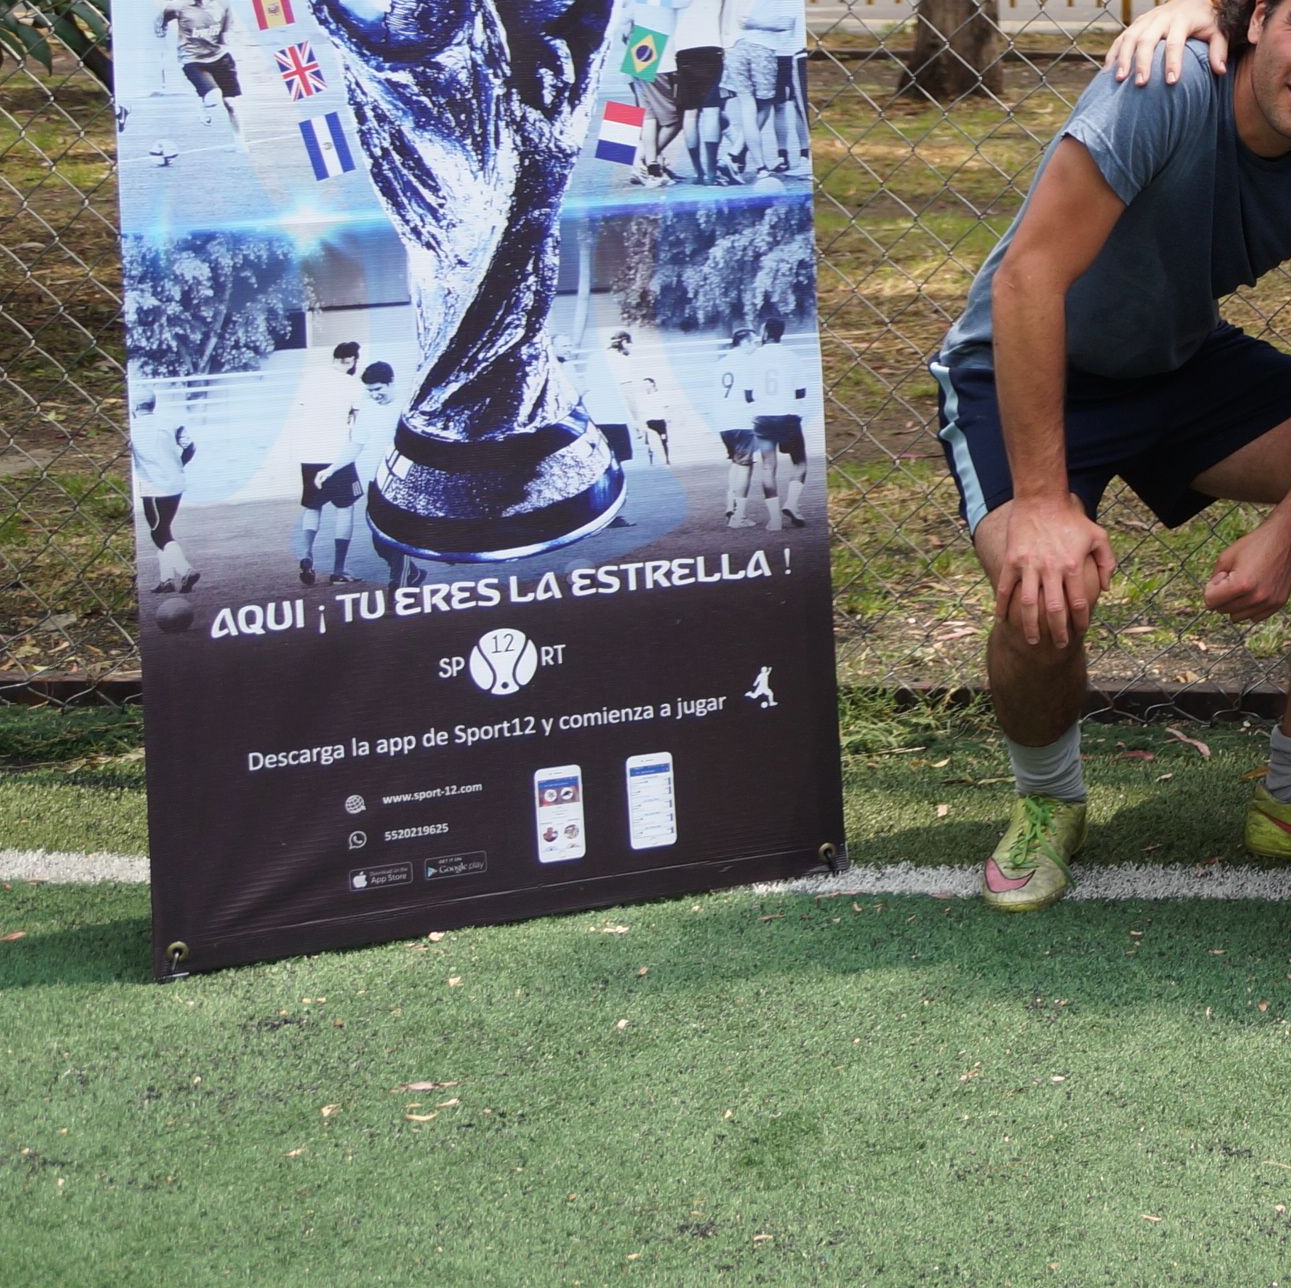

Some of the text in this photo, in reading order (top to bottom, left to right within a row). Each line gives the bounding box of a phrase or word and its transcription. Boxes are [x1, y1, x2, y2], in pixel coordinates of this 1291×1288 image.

[721, 372, 734, 399] 9
[210, 599, 305, 639] AQUI
[335, 590, 386, 622] TU
[395, 578, 501, 616] ERES
[509, 571, 563, 603] LA
[571, 550, 772, 597] ESTRELLA
[491, 633, 515, 654] 12
[438, 644, 567, 679] SP RT
[248, 695, 727, 771] Descarga la app de Sport12 y comienza a jugar
[382, 783, 483, 805] www.sport-12.com
[384, 822, 449, 842] 5520219625
